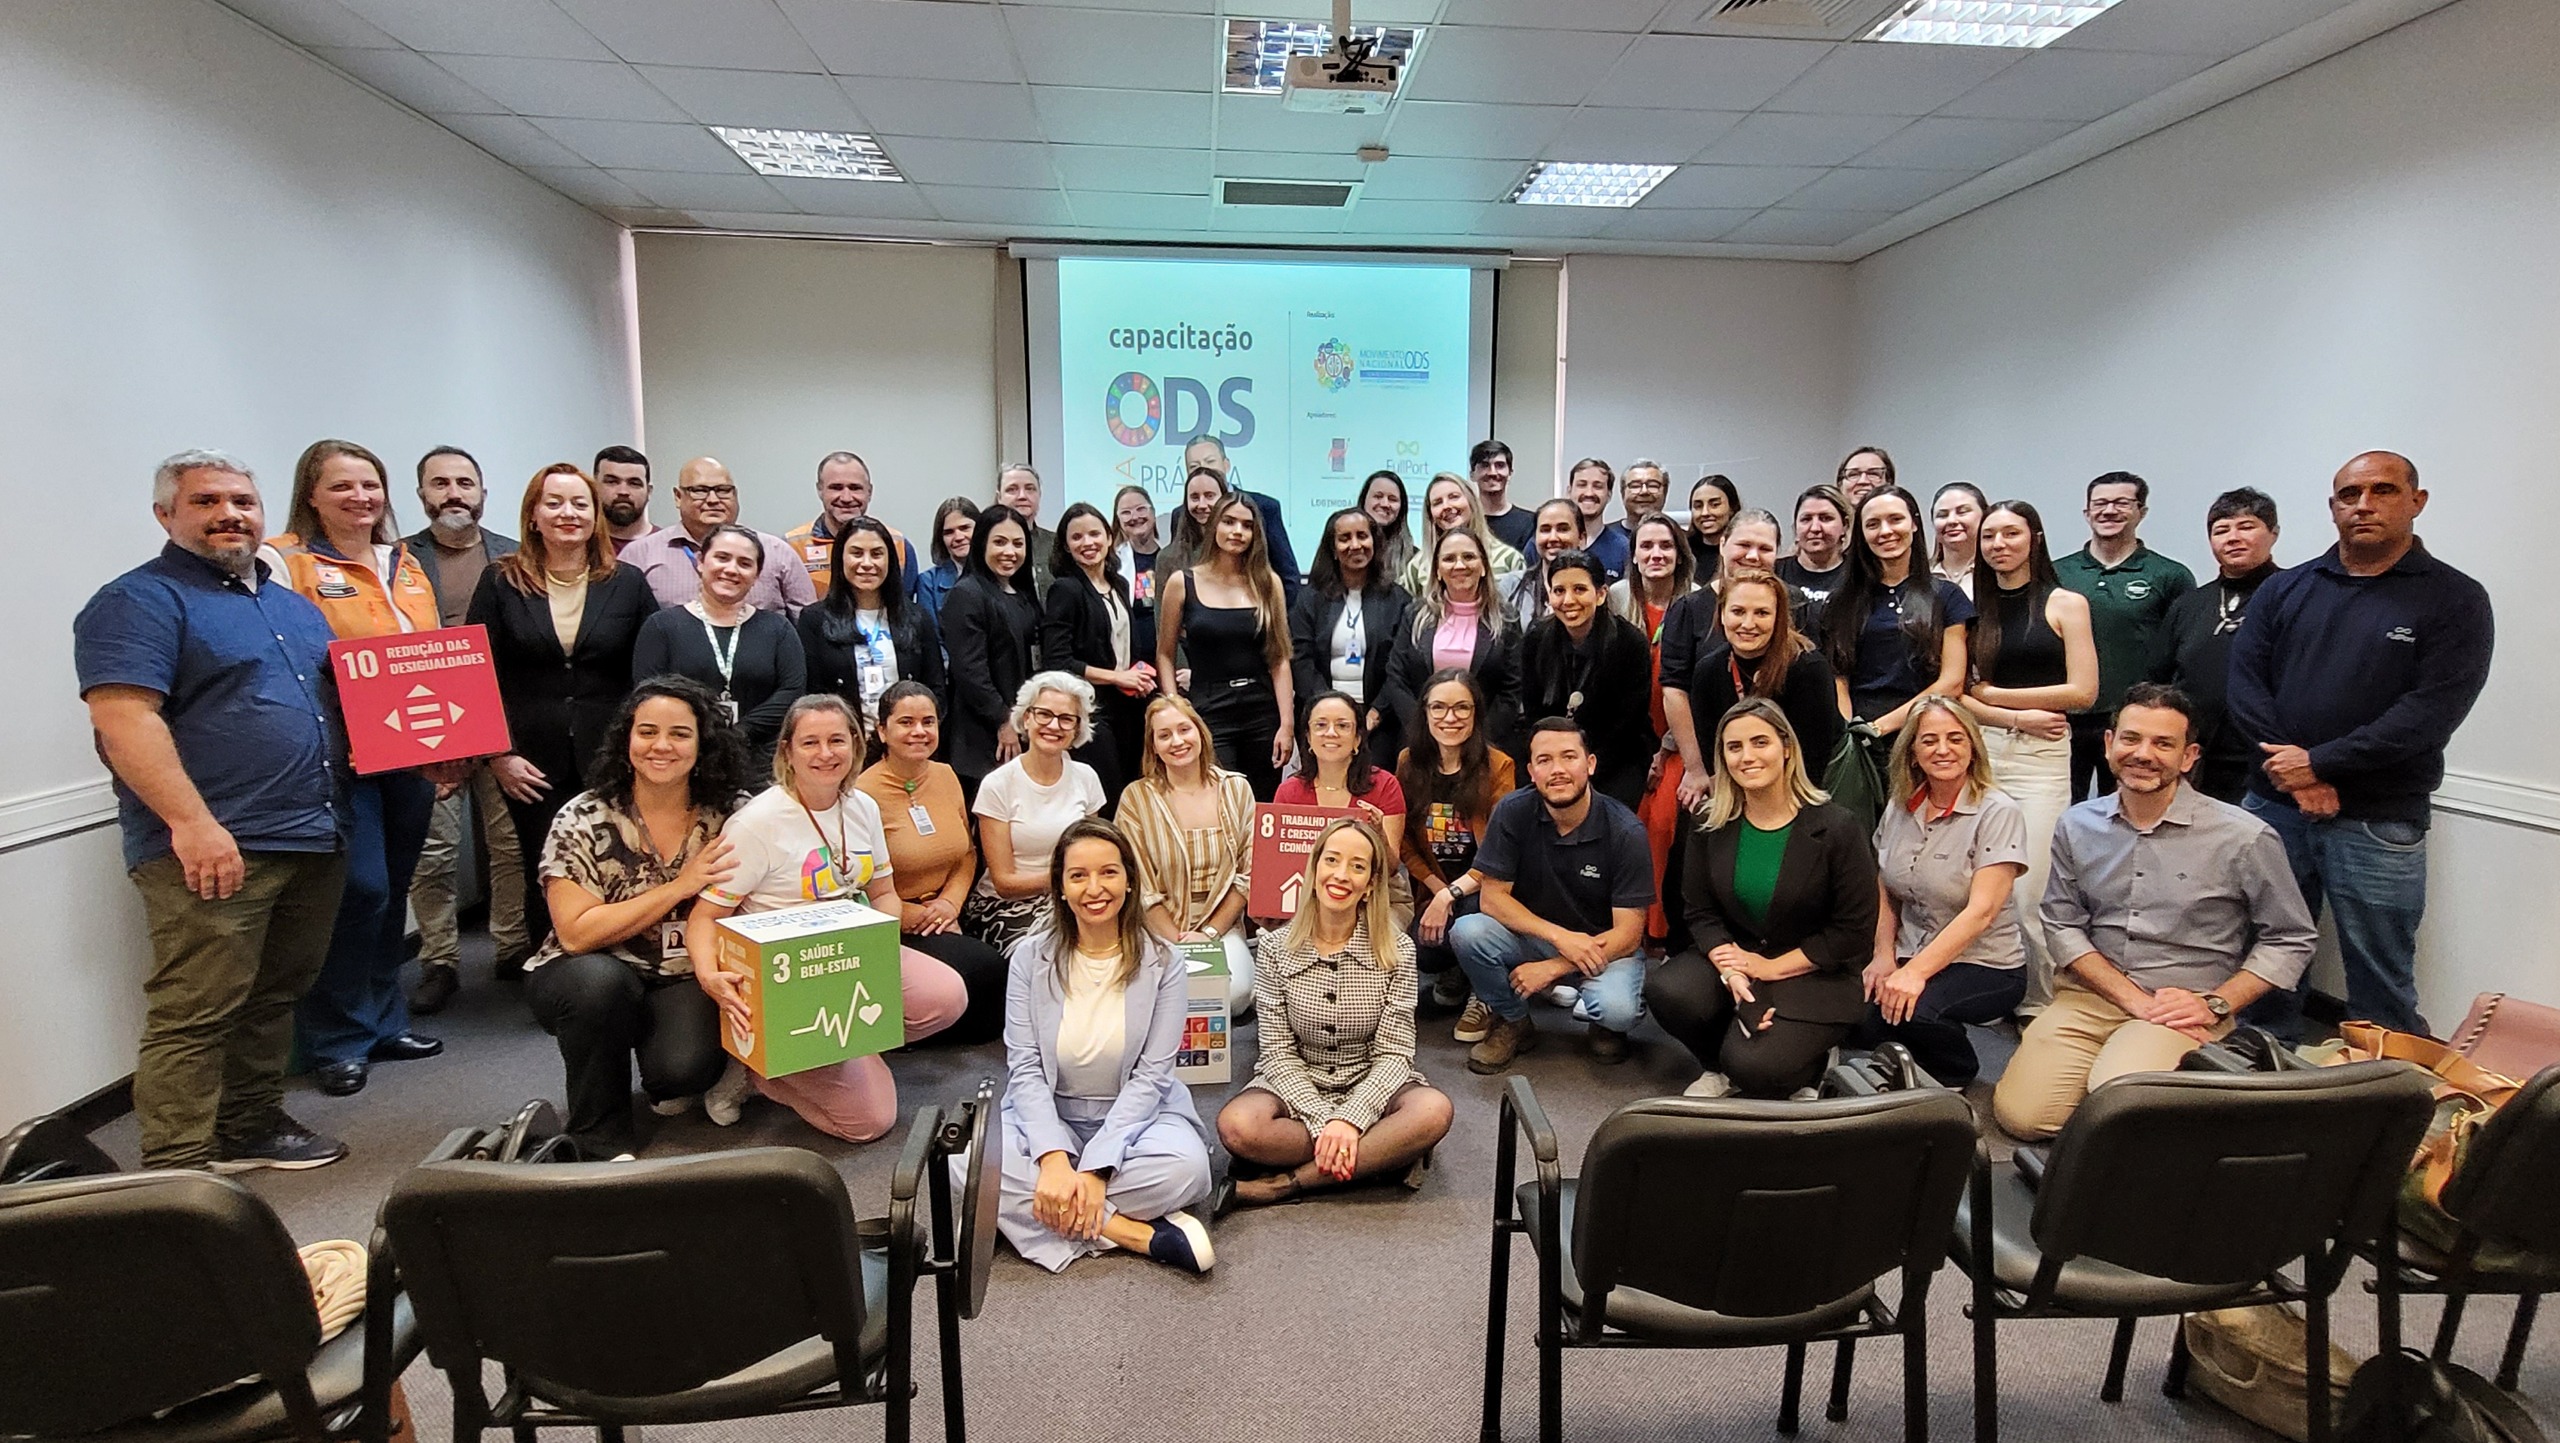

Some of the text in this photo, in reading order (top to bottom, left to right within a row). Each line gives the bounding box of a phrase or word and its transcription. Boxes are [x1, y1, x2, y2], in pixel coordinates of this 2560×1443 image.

[1109, 321, 1254, 357] capacitação
[1359, 350, 1430, 370] MOVIMENTO ODS
[1359, 360, 1404, 369] NACIONAL
[1105, 371, 1256, 448] ODS
[385, 638, 471, 660] REDUÇÃO DAS
[340, 649, 380, 680] 10
[388, 652, 486, 676] DESIGUALDADES
[1260, 812, 1275, 839] 8
[1281, 814, 1326, 827] TRABALHO
[1280, 828, 1286, 839] E
[799, 942, 845, 963] SAÚDE E
[771, 952, 791, 984] 3
[800, 955, 861, 980] BEM-ESTAR
